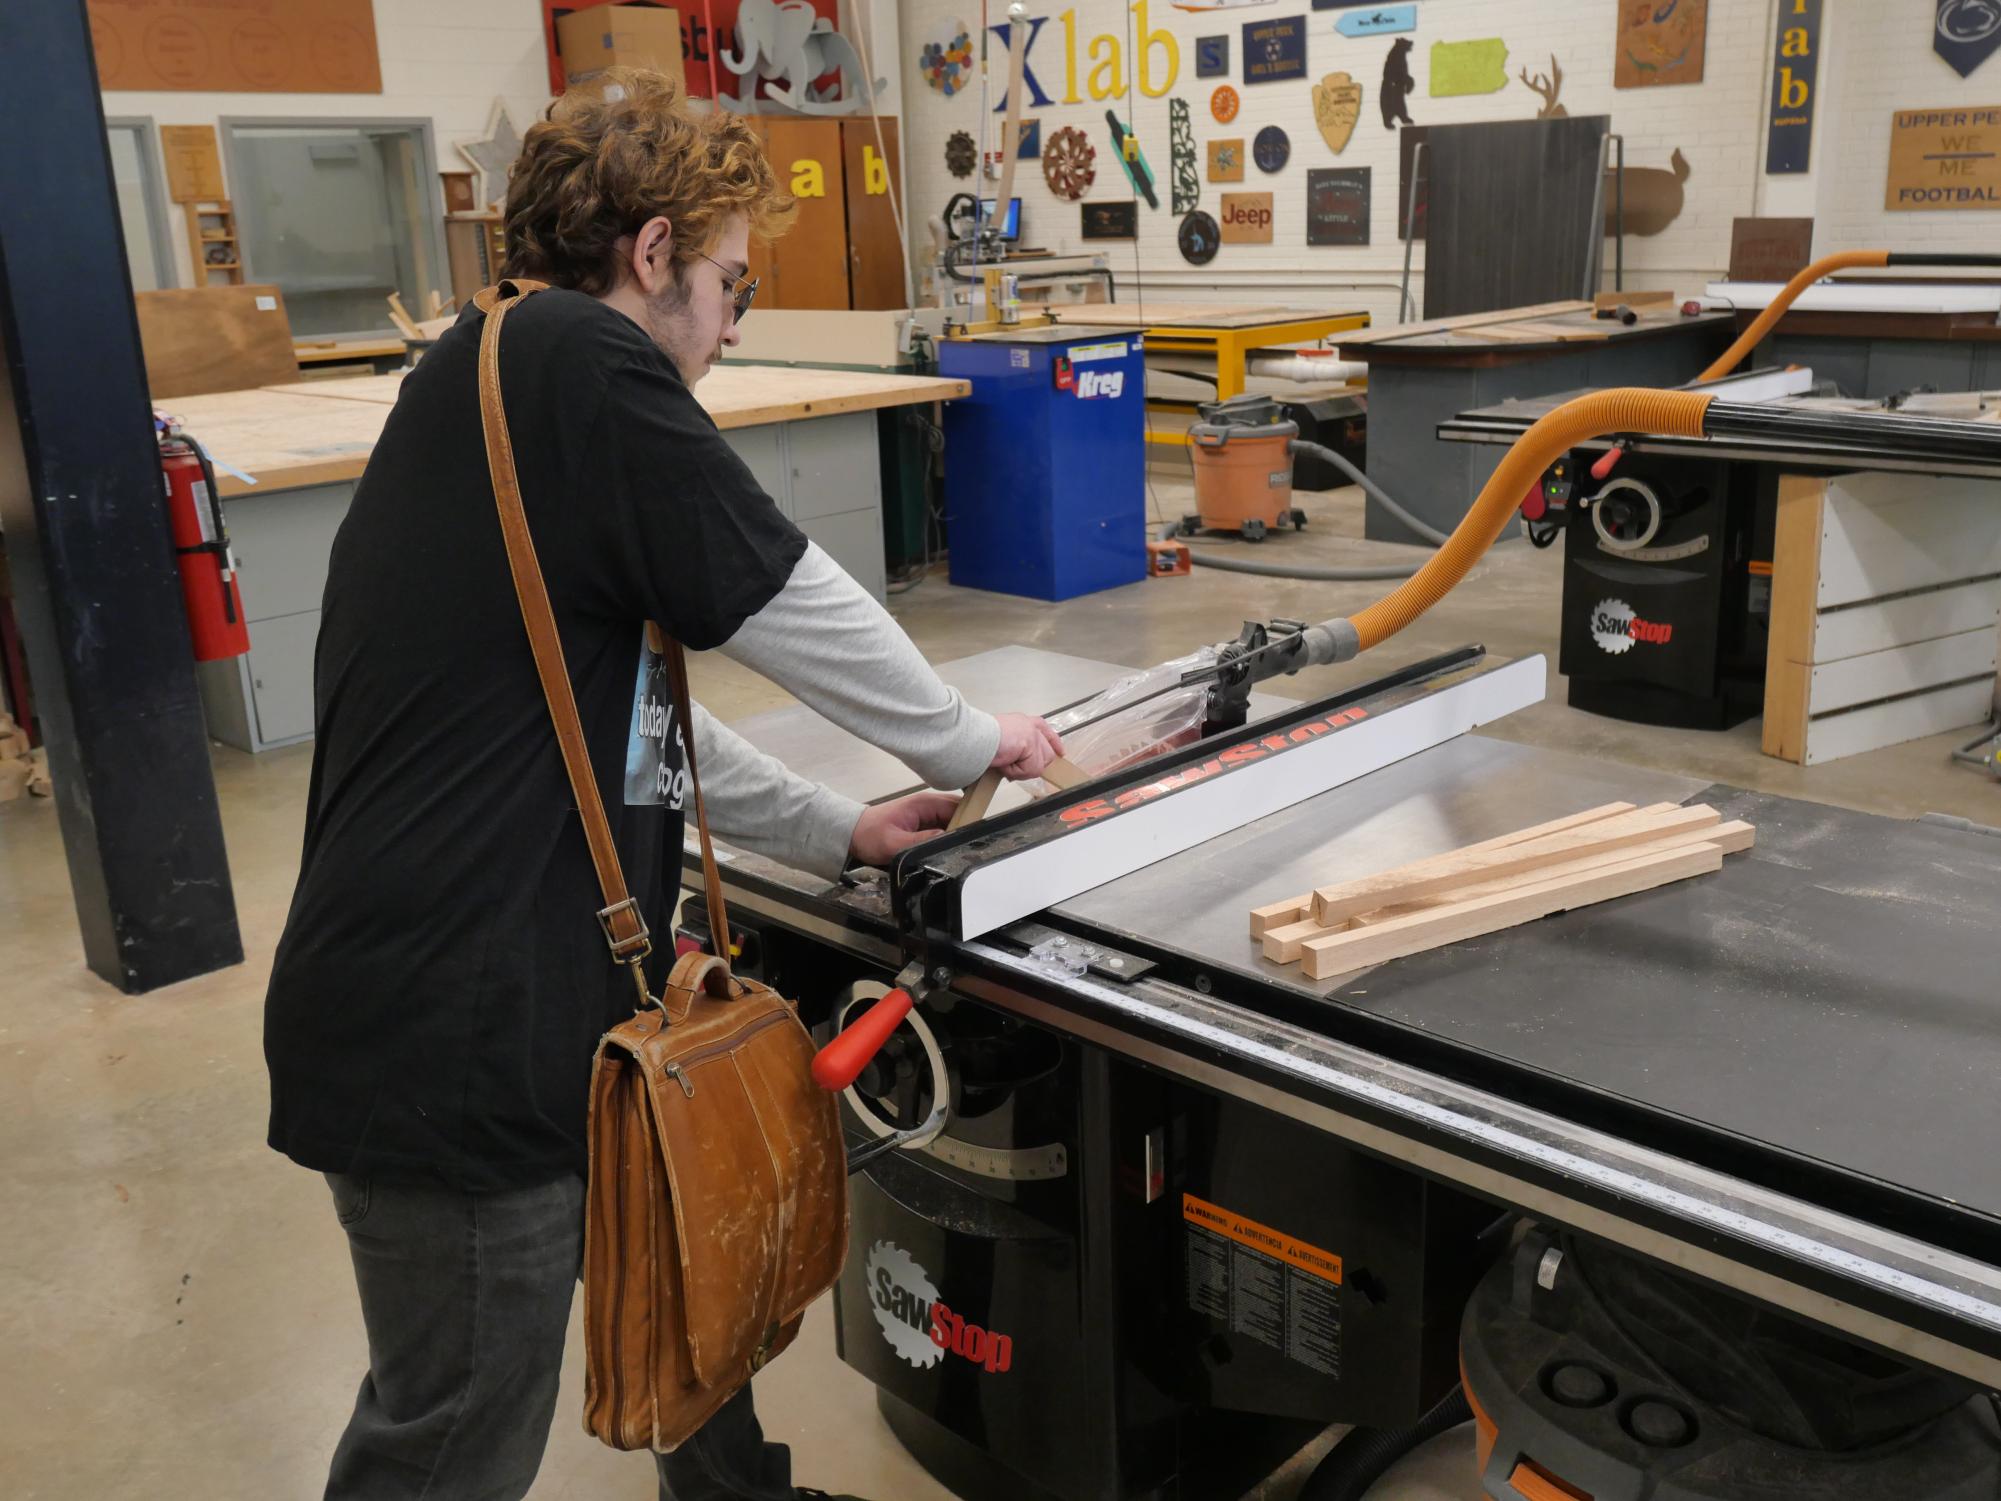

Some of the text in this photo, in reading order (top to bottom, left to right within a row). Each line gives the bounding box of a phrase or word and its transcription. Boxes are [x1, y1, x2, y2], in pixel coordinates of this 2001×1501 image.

[1898, 111, 1967, 128] UPPER
[1941, 135, 1983, 152] WE
[1939, 159, 1977, 176] ME
[1222, 203, 1272, 230] Jeep
[1077, 370, 1125, 399] Kreg
[1596, 611, 1673, 645] SawStop
[637, 695, 674, 749] today
[875, 1266, 1013, 1373] SawStop
